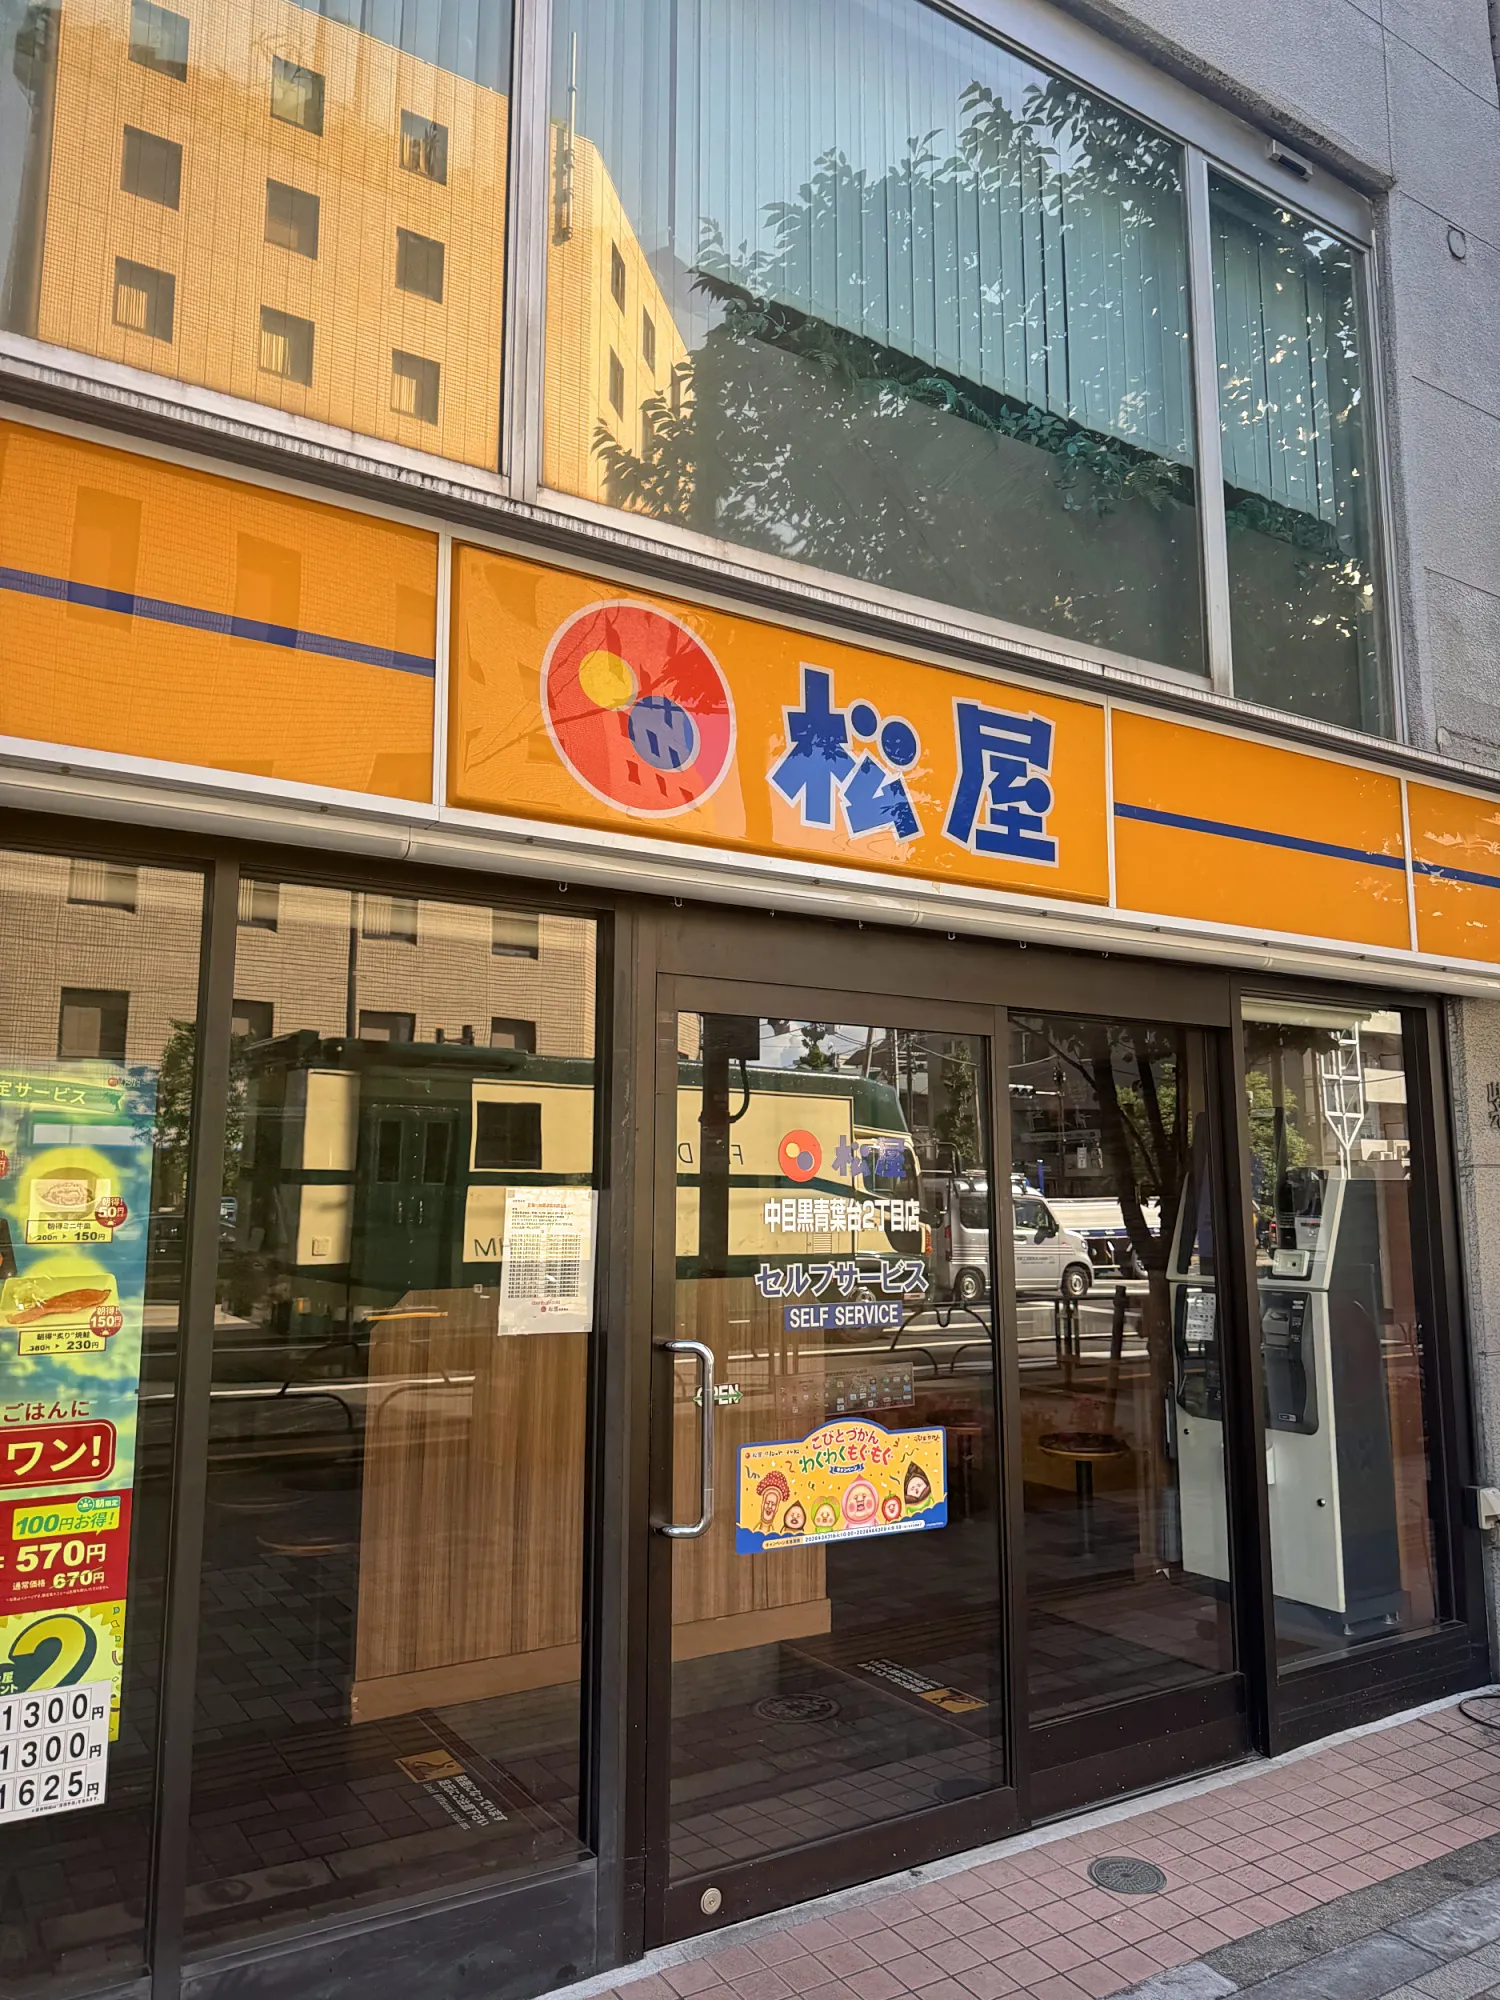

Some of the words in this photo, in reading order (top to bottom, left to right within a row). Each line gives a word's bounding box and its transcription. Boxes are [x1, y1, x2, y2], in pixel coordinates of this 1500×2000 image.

[768, 664, 1058, 866] 松屋
[832, 1135, 907, 1178] 松屋
[764, 1198, 920, 1232] 中目黒青葉台2丁目店
[74, 1231, 106, 1241] 150円
[755, 1260, 929, 1297] セルフサービス
[789, 1306, 829, 1329] SELF
[835, 1303, 899, 1327] SERVICE
[66, 1340, 99, 1351] 230円
[4, 1400, 90, 1422] ごはんに
[811, 1427, 880, 1451] こびとづかん
[16, 1511, 116, 1536] 100円お得!
[15, 1539, 107, 1572] 570円
[12, 1578, 46, 1591] 通常価格
[52, 1569, 105, 1589] 670円
